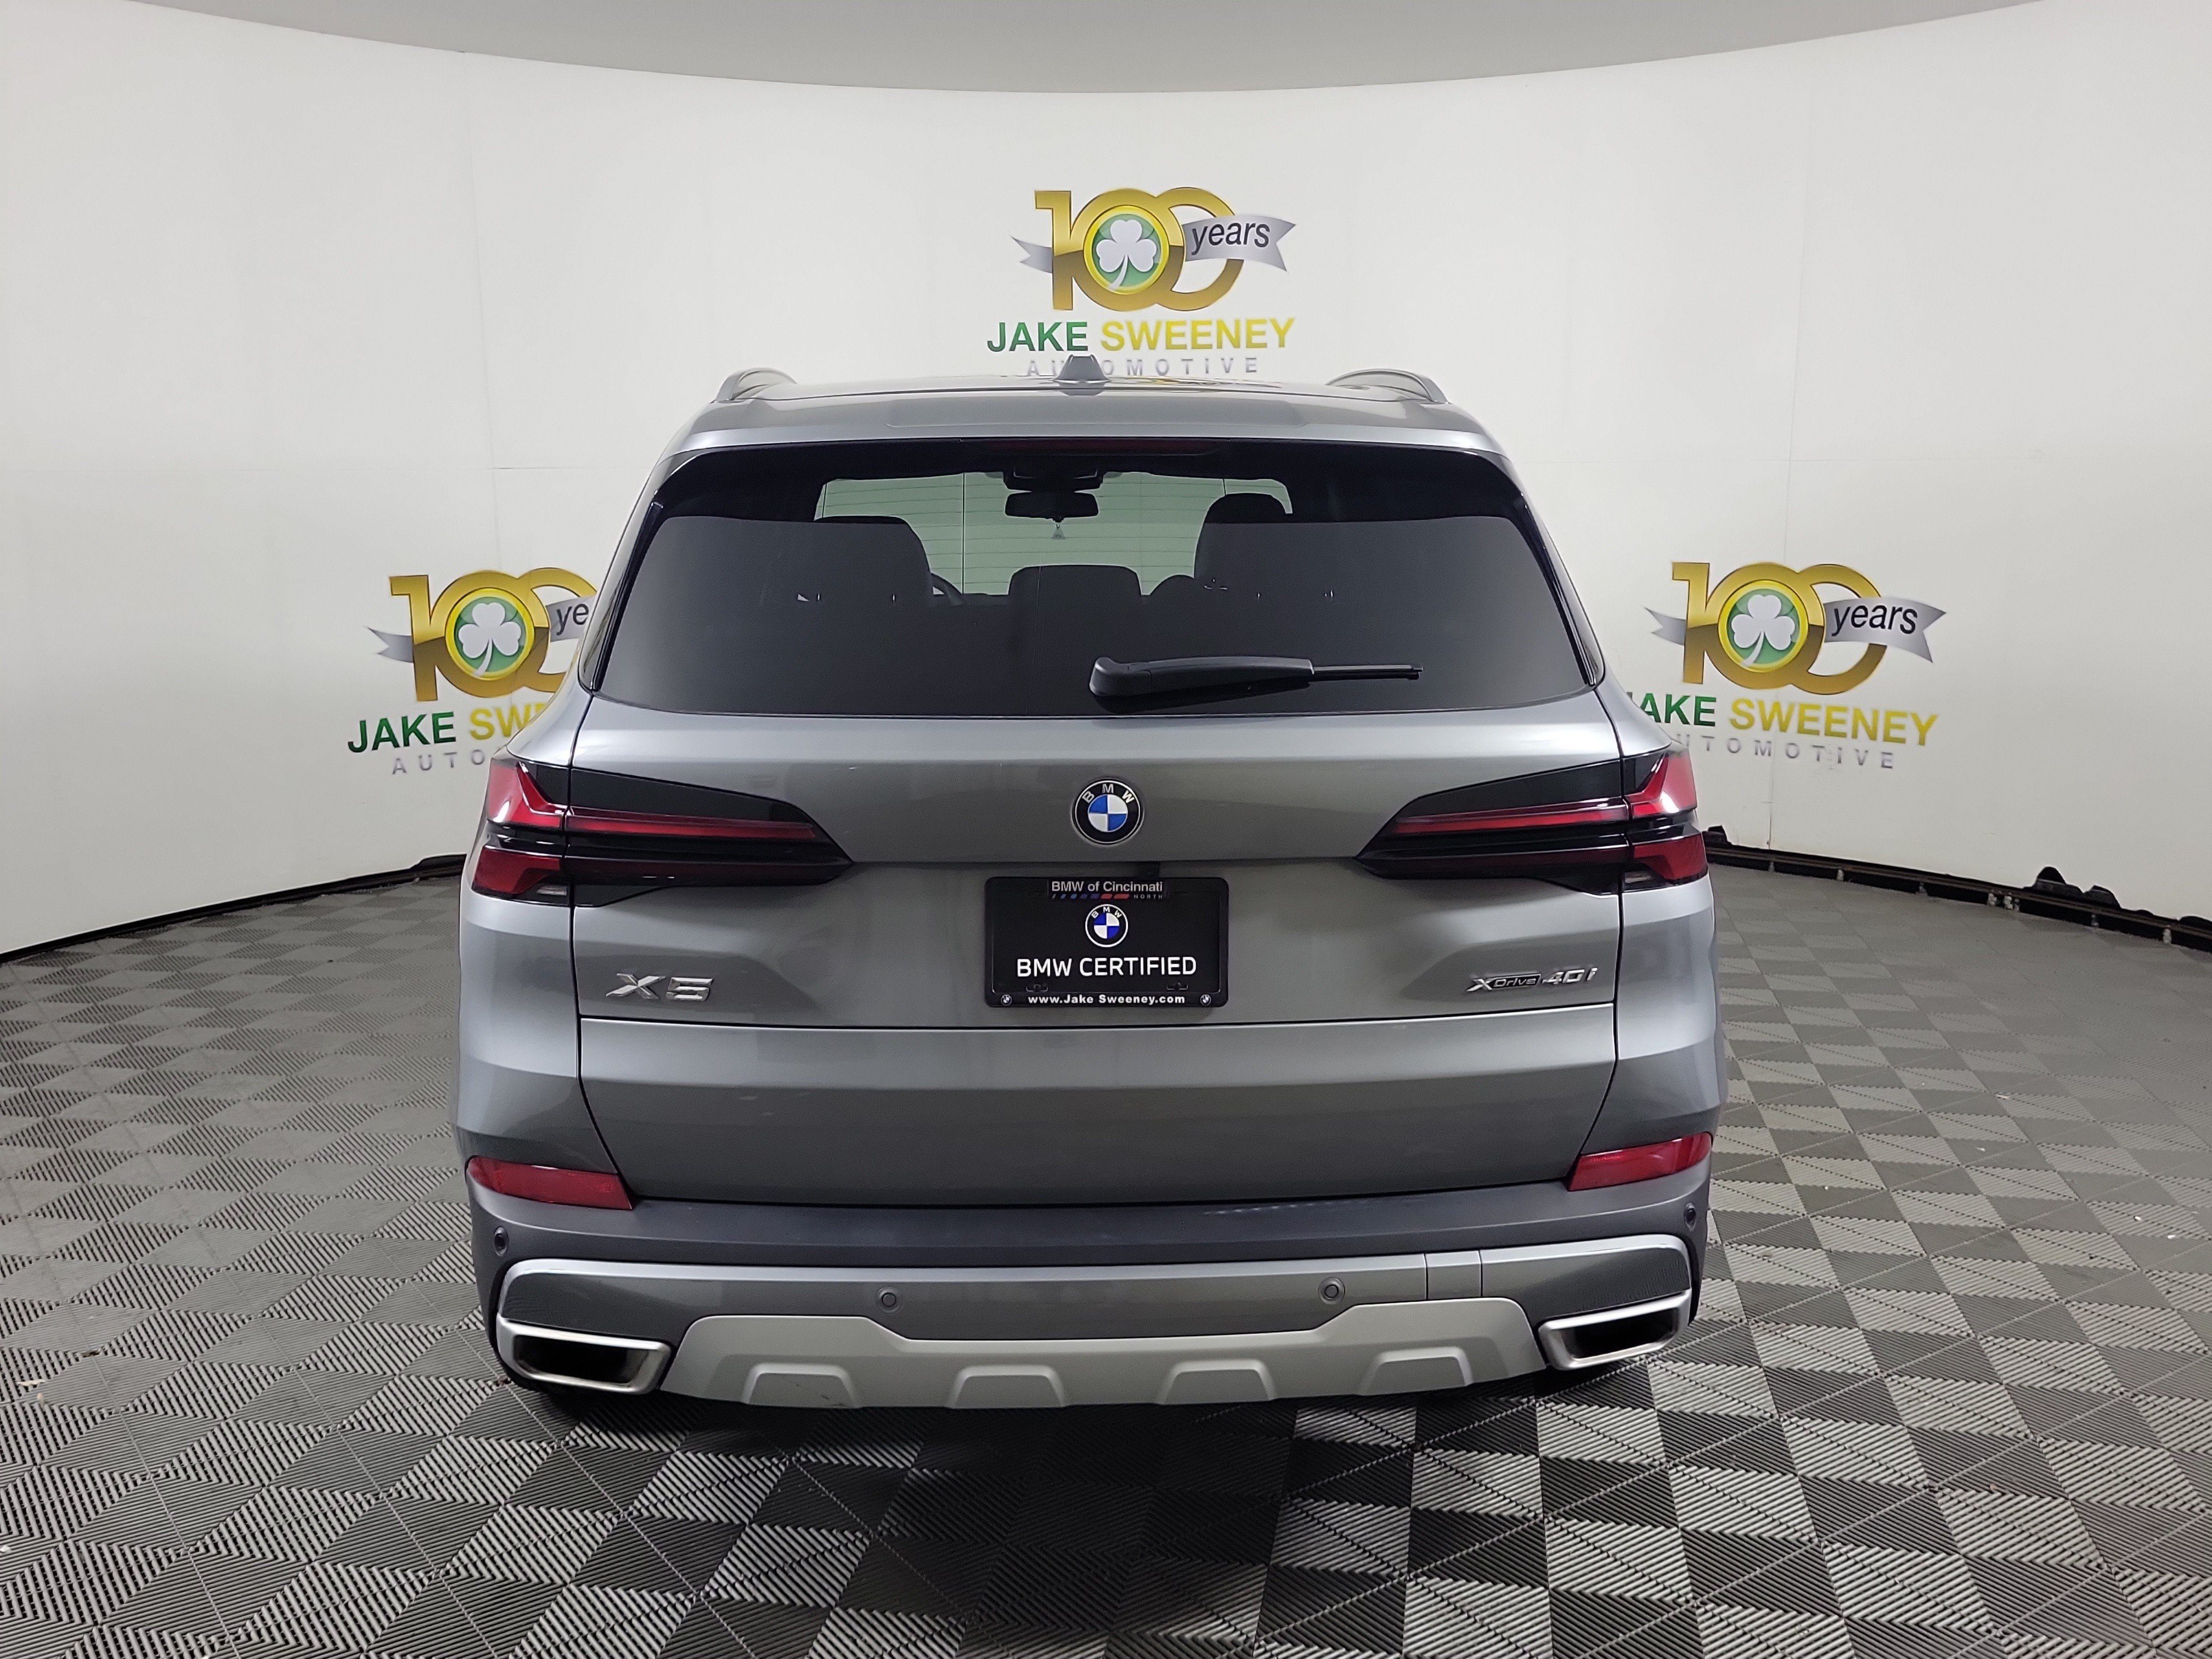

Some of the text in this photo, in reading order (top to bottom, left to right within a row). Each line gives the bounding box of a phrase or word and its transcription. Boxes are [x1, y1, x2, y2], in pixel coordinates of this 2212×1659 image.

[1035, 187, 1271, 312] 100 years
[987, 318, 1295, 353] JAKE SWEENEY
[1027, 357, 1258, 377] AUOMOTIVE
[1672, 561, 1918, 695] 100 years
[1627, 691, 1939, 747] AKE SWEENEY
[347, 711, 457, 753] JAKE
[1082, 783, 1135, 804] BMW
[1052, 881, 1163, 892] BMW of Cincinnati
[1091, 906, 1122, 919] BMW
[1017, 956, 1197, 977] BMW CERTIFIED
[605, 973, 714, 1002] X5
[1028, 994, 1186, 1006] www.Jake Sweeney.com
